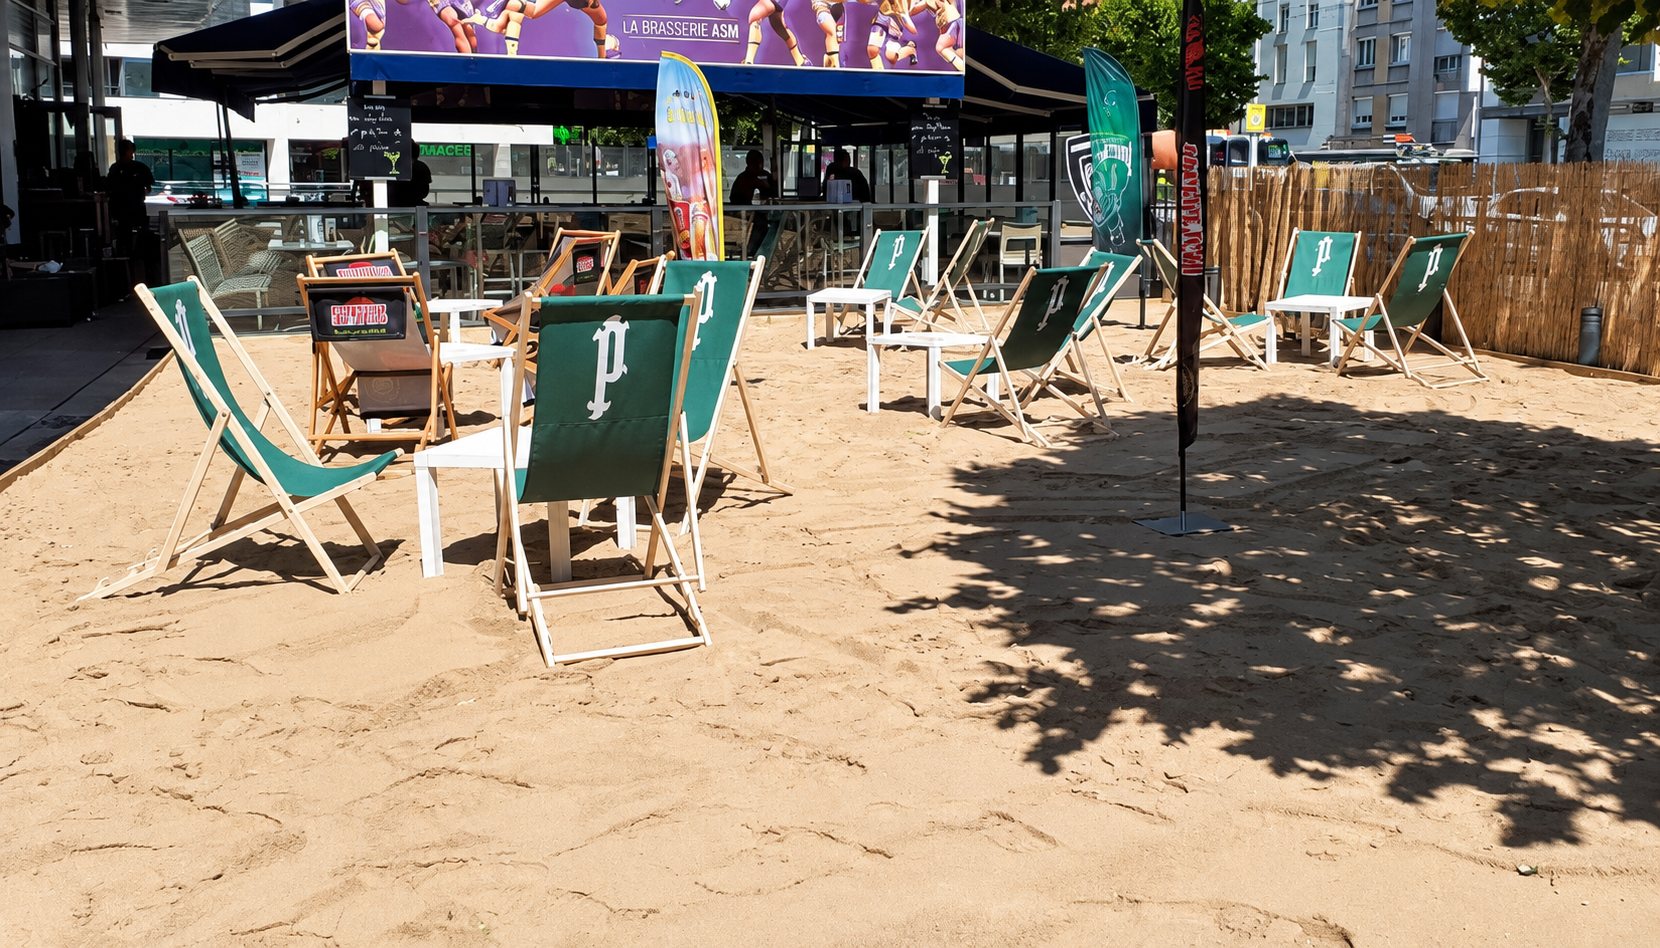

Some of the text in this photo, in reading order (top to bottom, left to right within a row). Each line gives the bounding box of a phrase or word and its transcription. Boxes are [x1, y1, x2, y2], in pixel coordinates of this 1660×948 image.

[623, 20, 739, 39] LA BRASSERIE ASM
